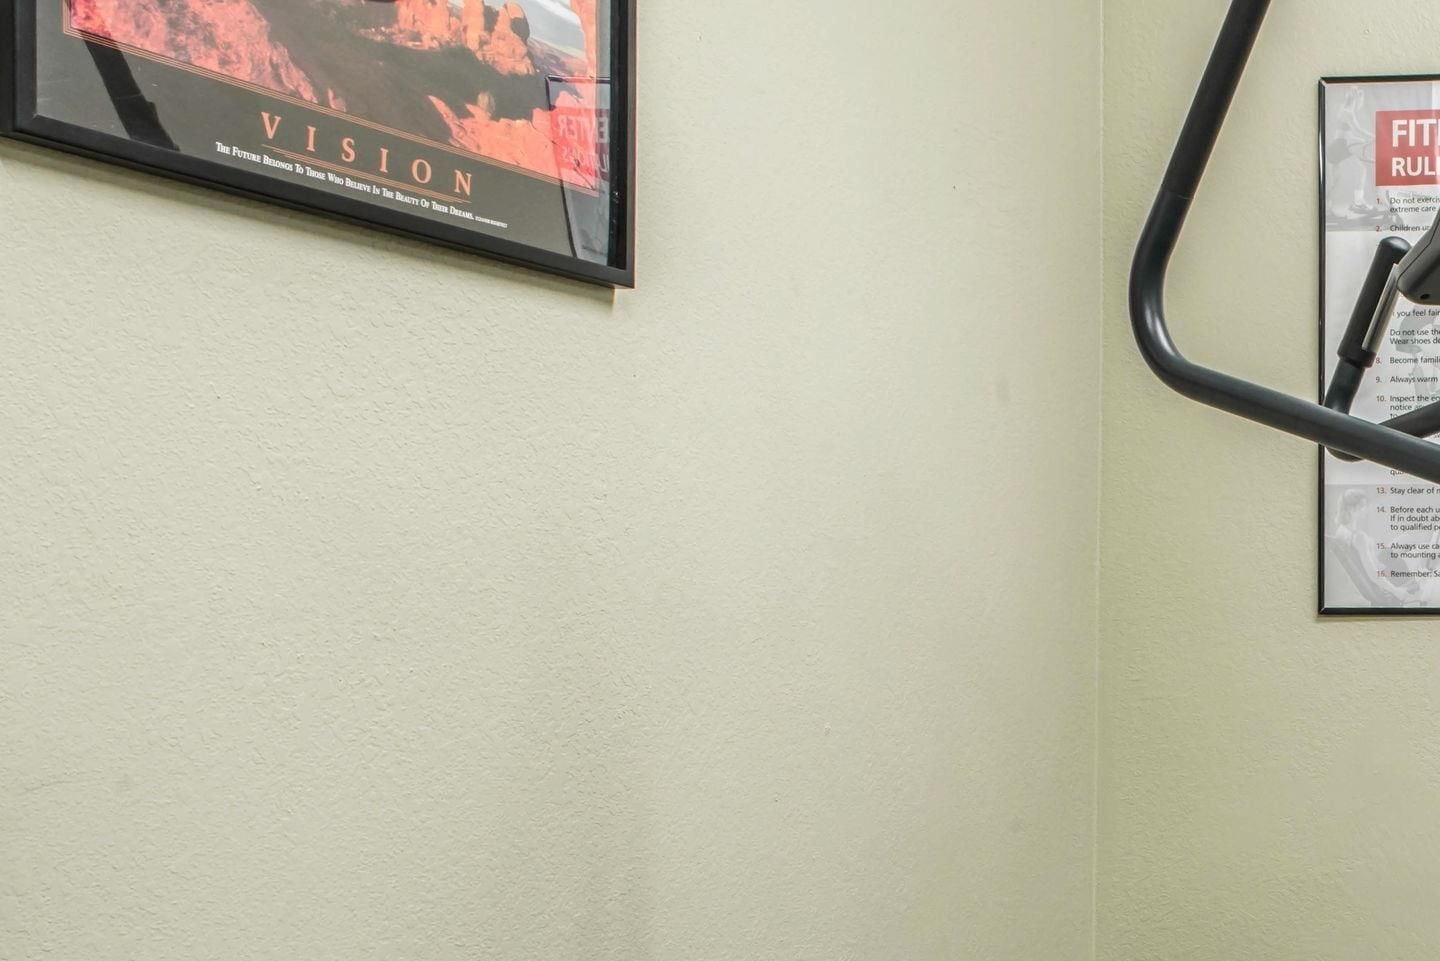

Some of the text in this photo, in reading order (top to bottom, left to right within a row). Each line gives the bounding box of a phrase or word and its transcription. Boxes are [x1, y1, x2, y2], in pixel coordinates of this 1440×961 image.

[232, 146, 262, 163] FUTURE
[261, 111, 472, 195] VISION
[1389, 224, 1420, 232] Children
[1396, 310, 1411, 318] you
[1412, 308, 1427, 317] feel
[1389, 329, 1400, 337] Do
[1410, 337, 1431, 345] shoes
[1389, 356, 1419, 364] Become
[1389, 375, 1416, 385] Always
[1389, 395, 1415, 404] Inspect
[1417, 394, 1429, 402] the
[1390, 486, 1406, 496] Stay
[1406, 486, 1425, 494] clear
[1426, 486, 1435, 494] of
[1390, 506, 1415, 514] Before
[1416, 506, 1433, 514] each
[1400, 523, 1433, 532] qualified
[1390, 542, 1416, 552] Always
[1400, 551, 1437, 560] mounting
[1390, 570, 1433, 578] Remember:
